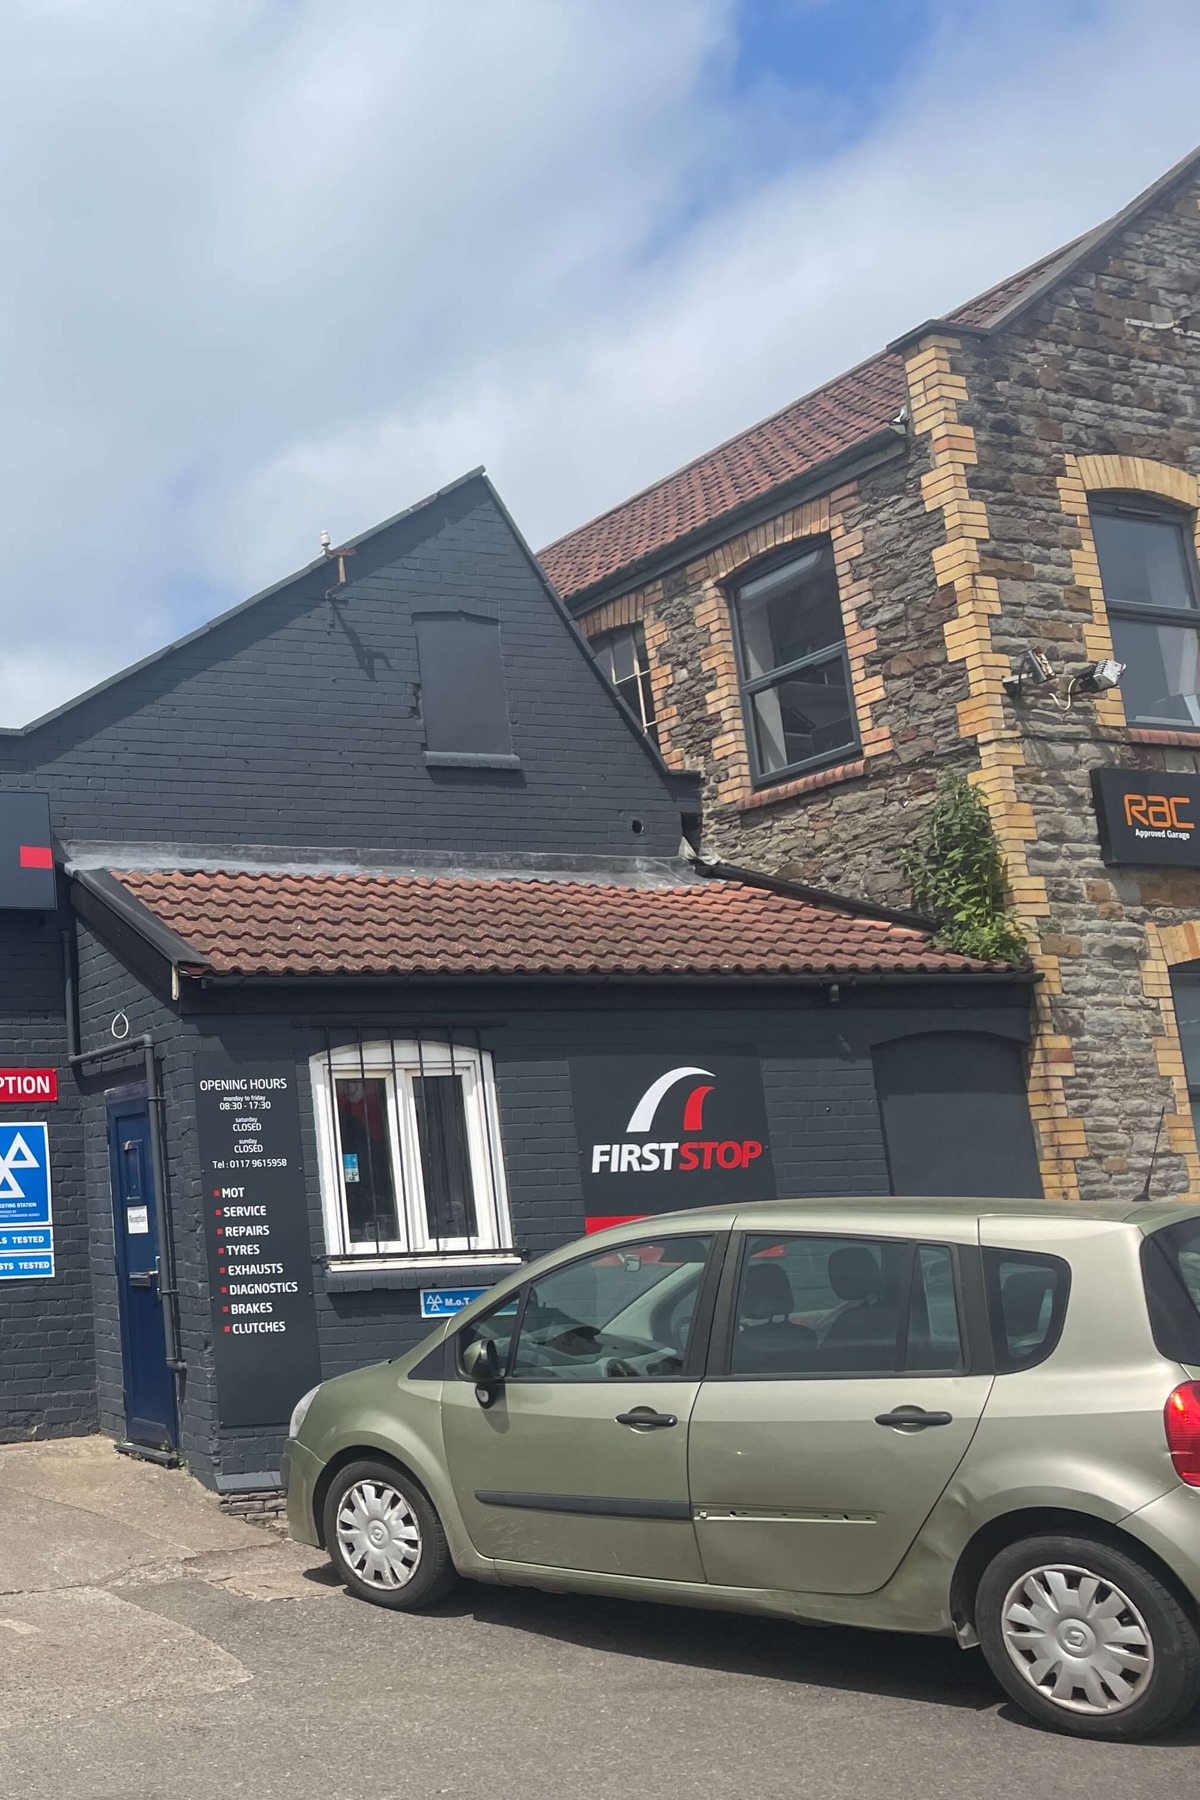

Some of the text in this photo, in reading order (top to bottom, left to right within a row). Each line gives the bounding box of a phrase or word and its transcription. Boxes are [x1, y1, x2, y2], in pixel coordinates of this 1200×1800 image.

[1135, 828, 1190, 841] Approved Garage
[200, 1078, 287, 1091] OPENING HOURS
[219, 1102, 242, 1110] 08:30
[249, 1101, 271, 1109] 17:30
[232, 1123, 262, 1131] CLOSED
[234, 1145, 263, 1153] CLOSED
[213, 1161, 225, 1169] Tel
[230, 1160, 250, 1168] 0117
[252, 1159, 287, 1168] 9615958
[222, 1187, 245, 1198] MOT
[223, 1206, 267, 1217] SERVICE
[225, 1225, 270, 1237] REPAIRS
[12, 1235, 45, 1244] TESTED
[226, 1245, 260, 1256] TYRES
[18, 1261, 50, 1270] TESTED
[228, 1263, 284, 1276] EXHAUSTS
[229, 1282, 298, 1296] DIAGNOSTICS
[231, 1303, 273, 1315] BRAKES
[232, 1321, 286, 1335] CLUTCHES
